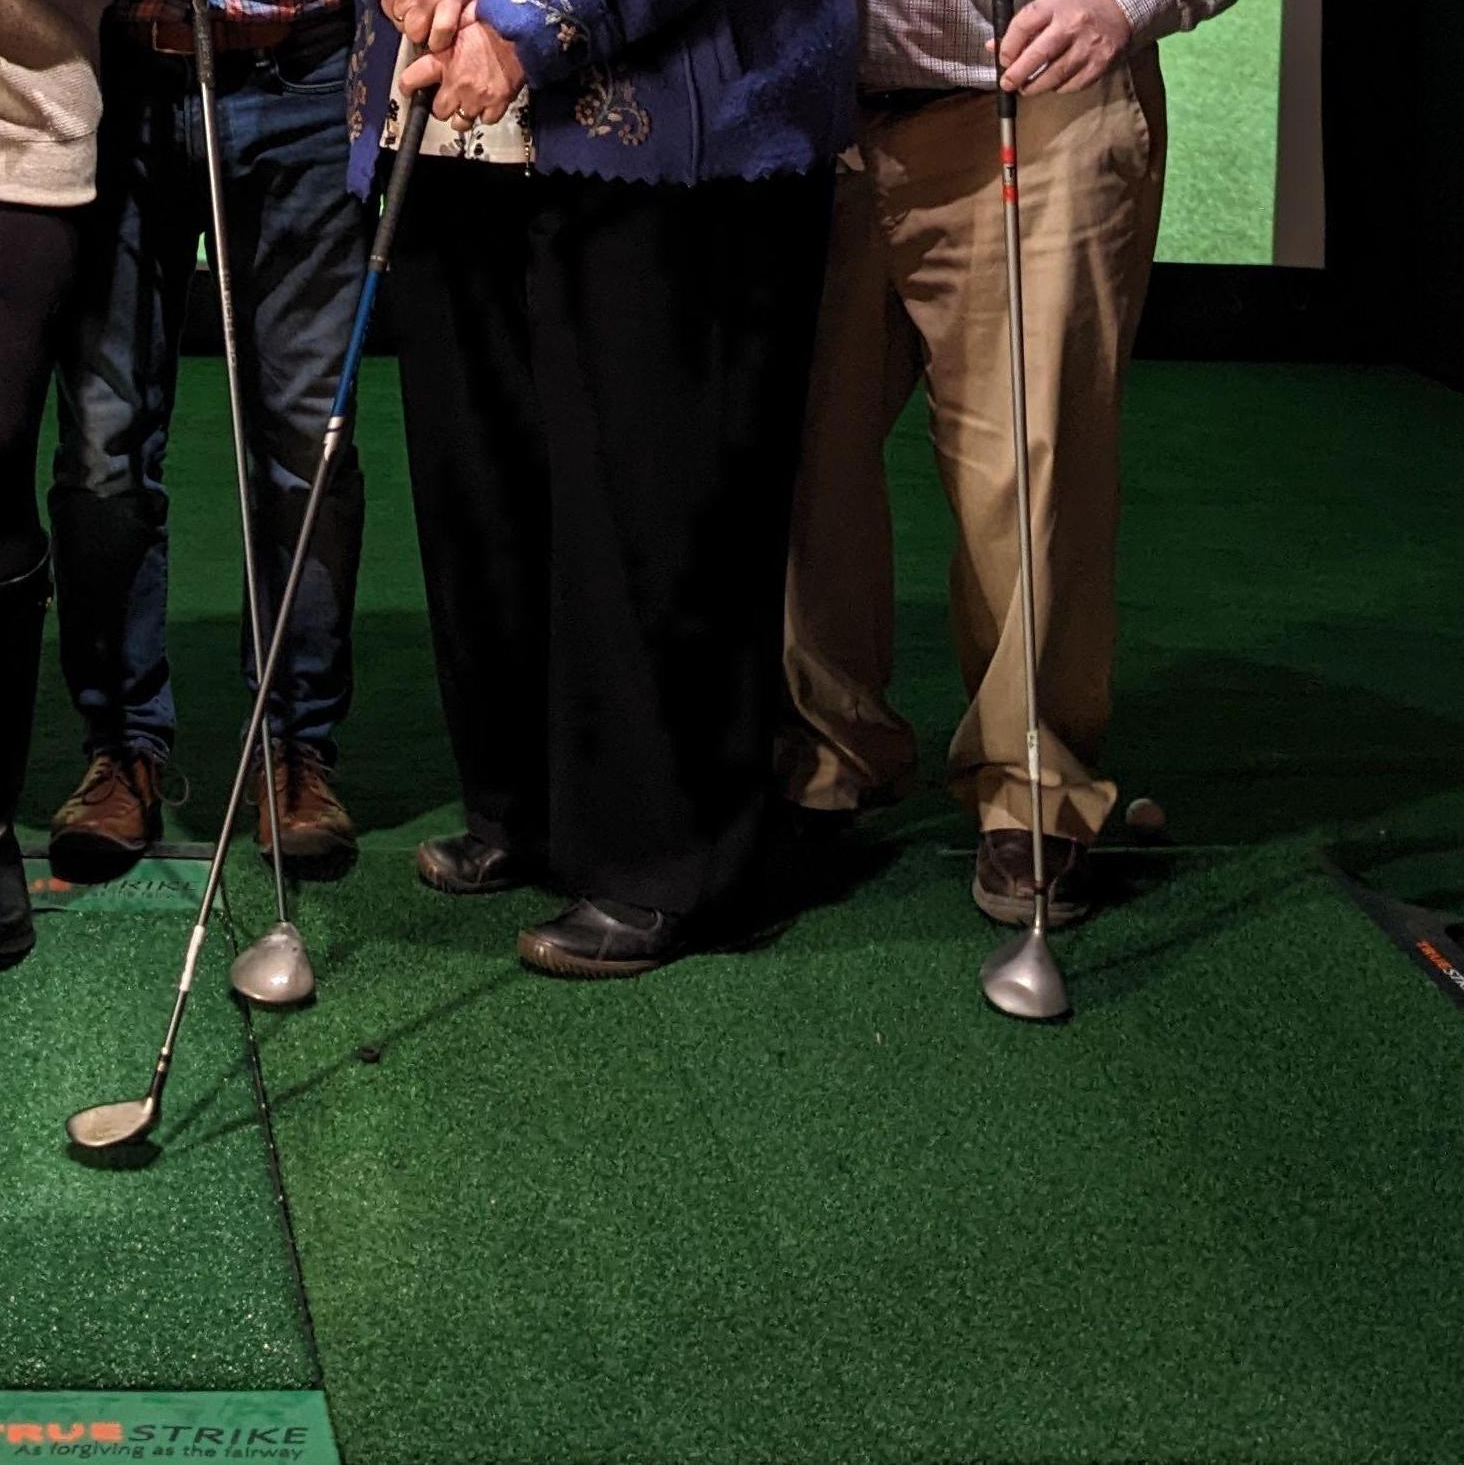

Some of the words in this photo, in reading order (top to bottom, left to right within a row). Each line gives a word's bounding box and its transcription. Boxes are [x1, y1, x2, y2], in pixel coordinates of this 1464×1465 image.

[15, 1444, 43, 1456] As
[49, 1441, 145, 1459] forgiving
[152, 1445, 174, 1457] as
[183, 1442, 217, 1458] the
[223, 1444, 304, 1461] fairway
